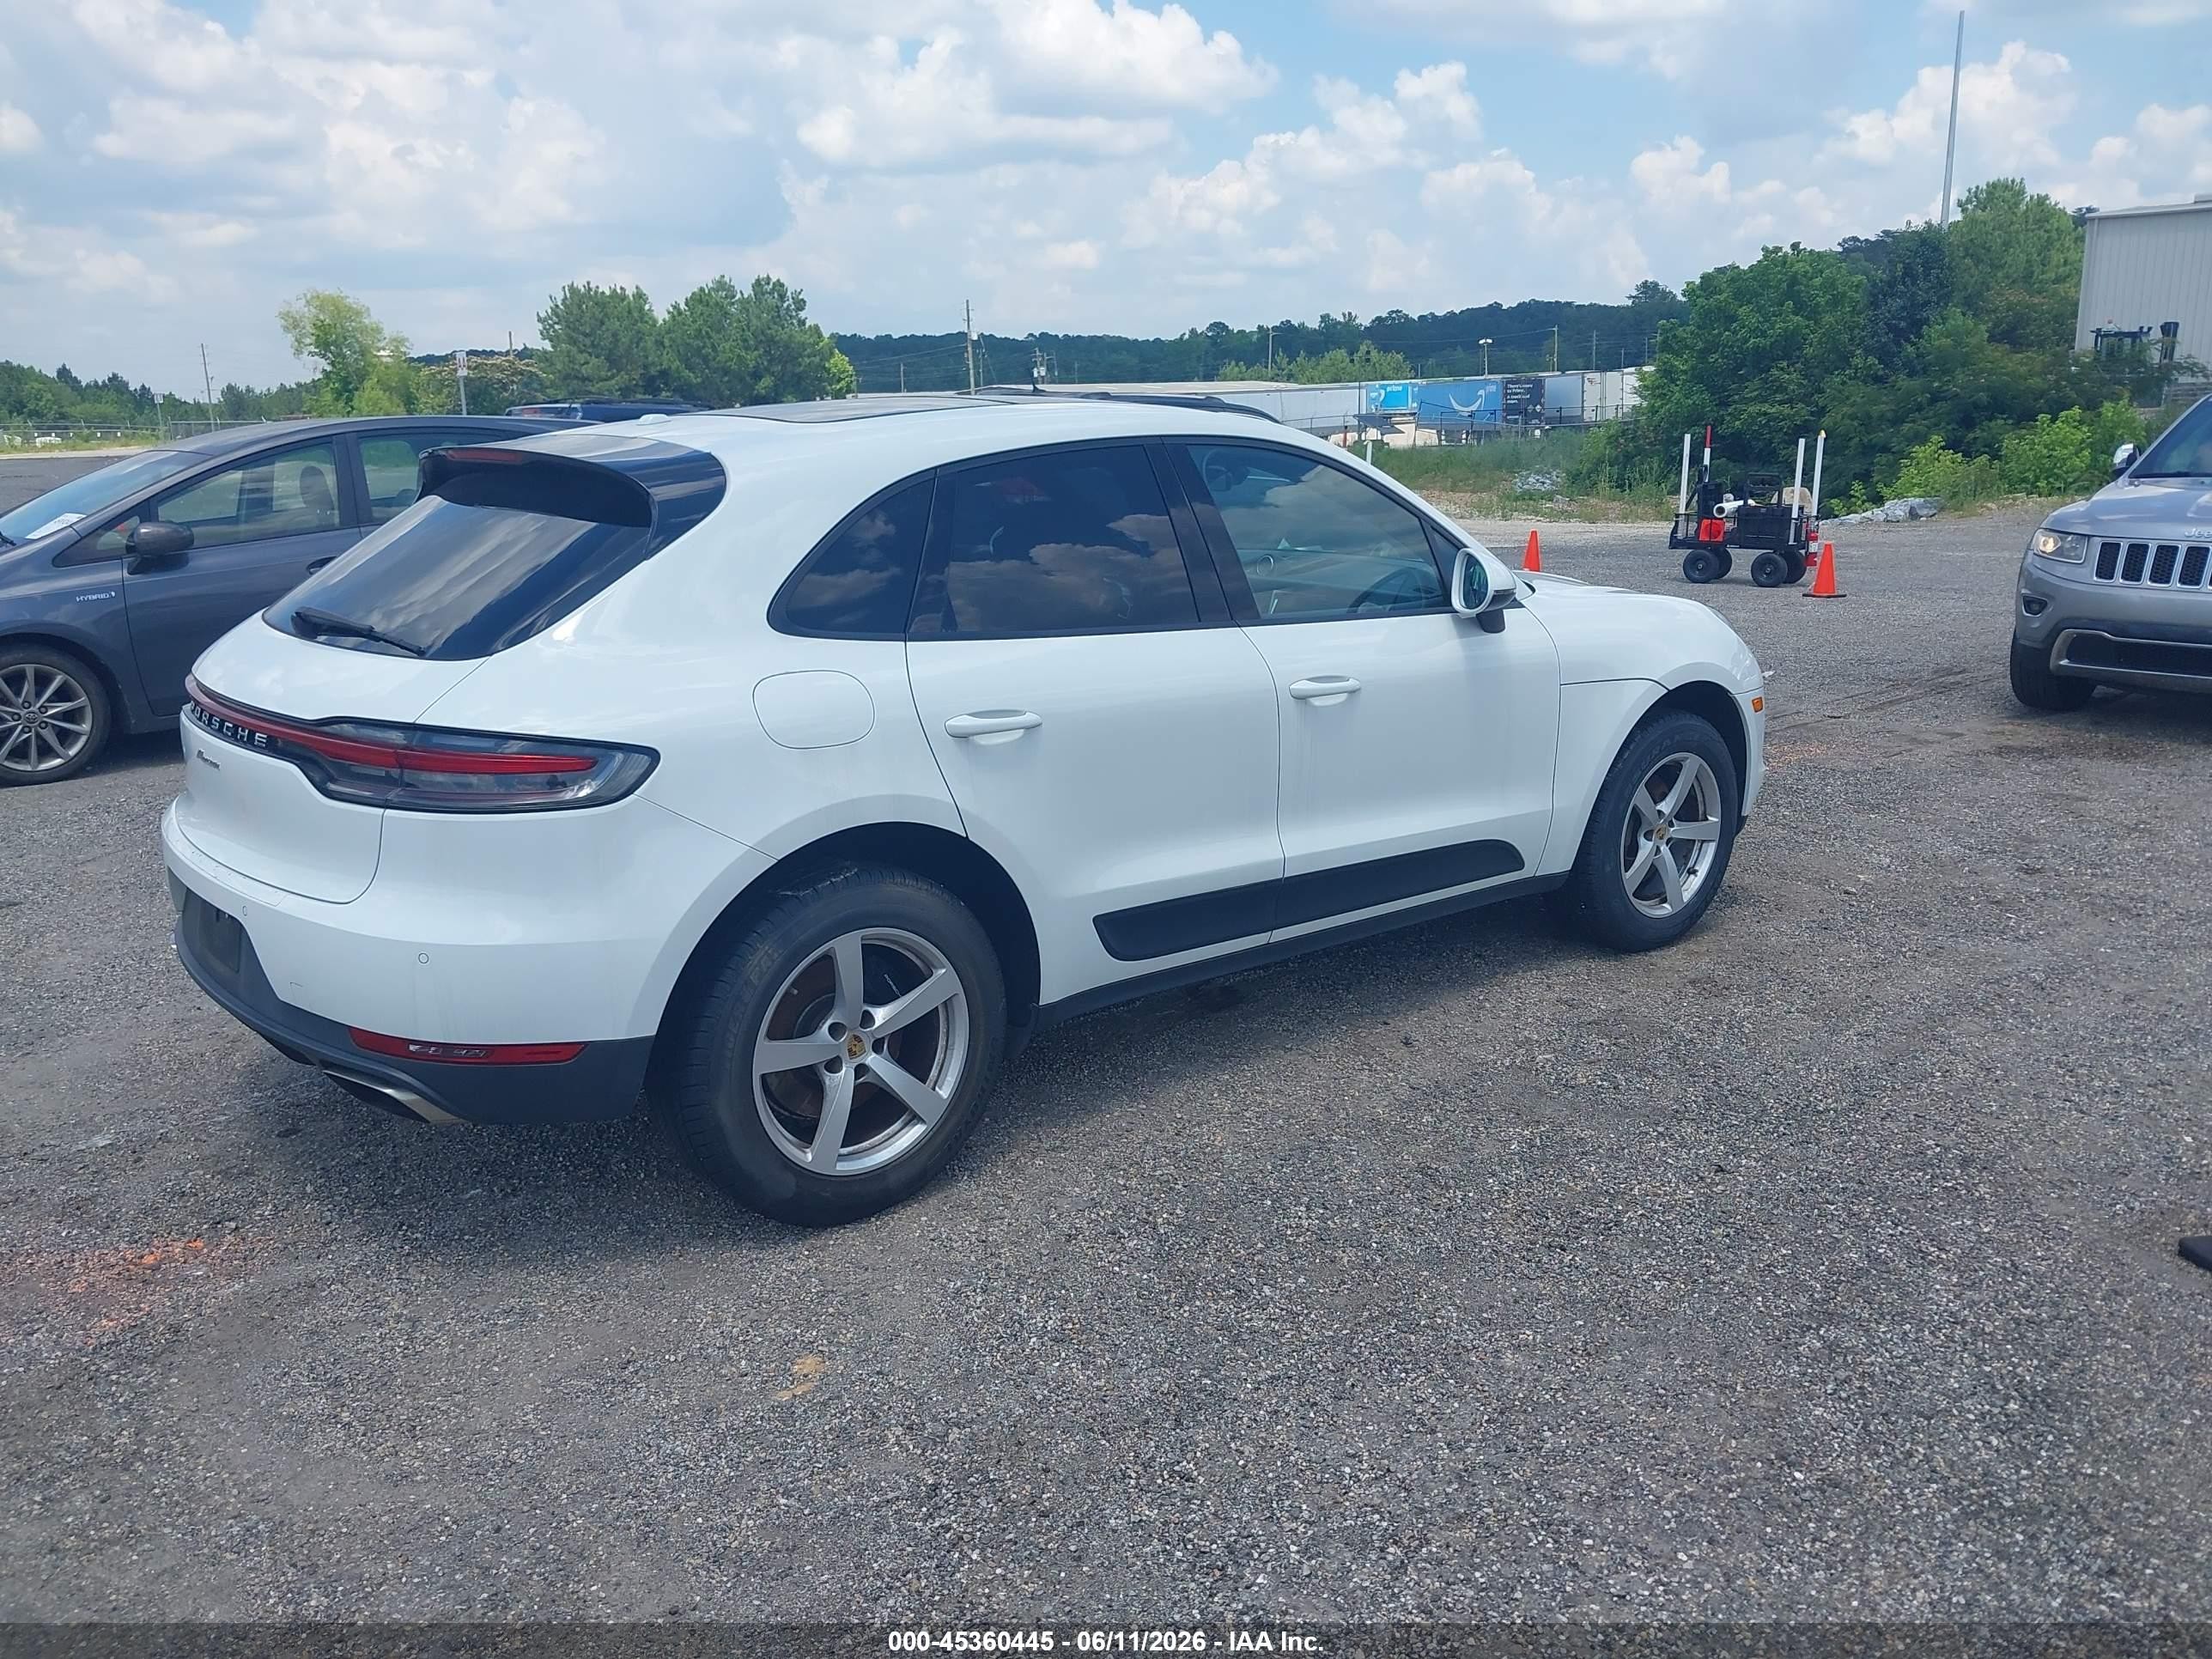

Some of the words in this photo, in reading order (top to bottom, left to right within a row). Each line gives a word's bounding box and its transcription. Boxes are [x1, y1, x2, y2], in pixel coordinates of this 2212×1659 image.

[2185, 528, 2212, 538] Jee
[76, 592, 110, 602] HYBRID
[191, 700, 268, 748] PORSCHE
